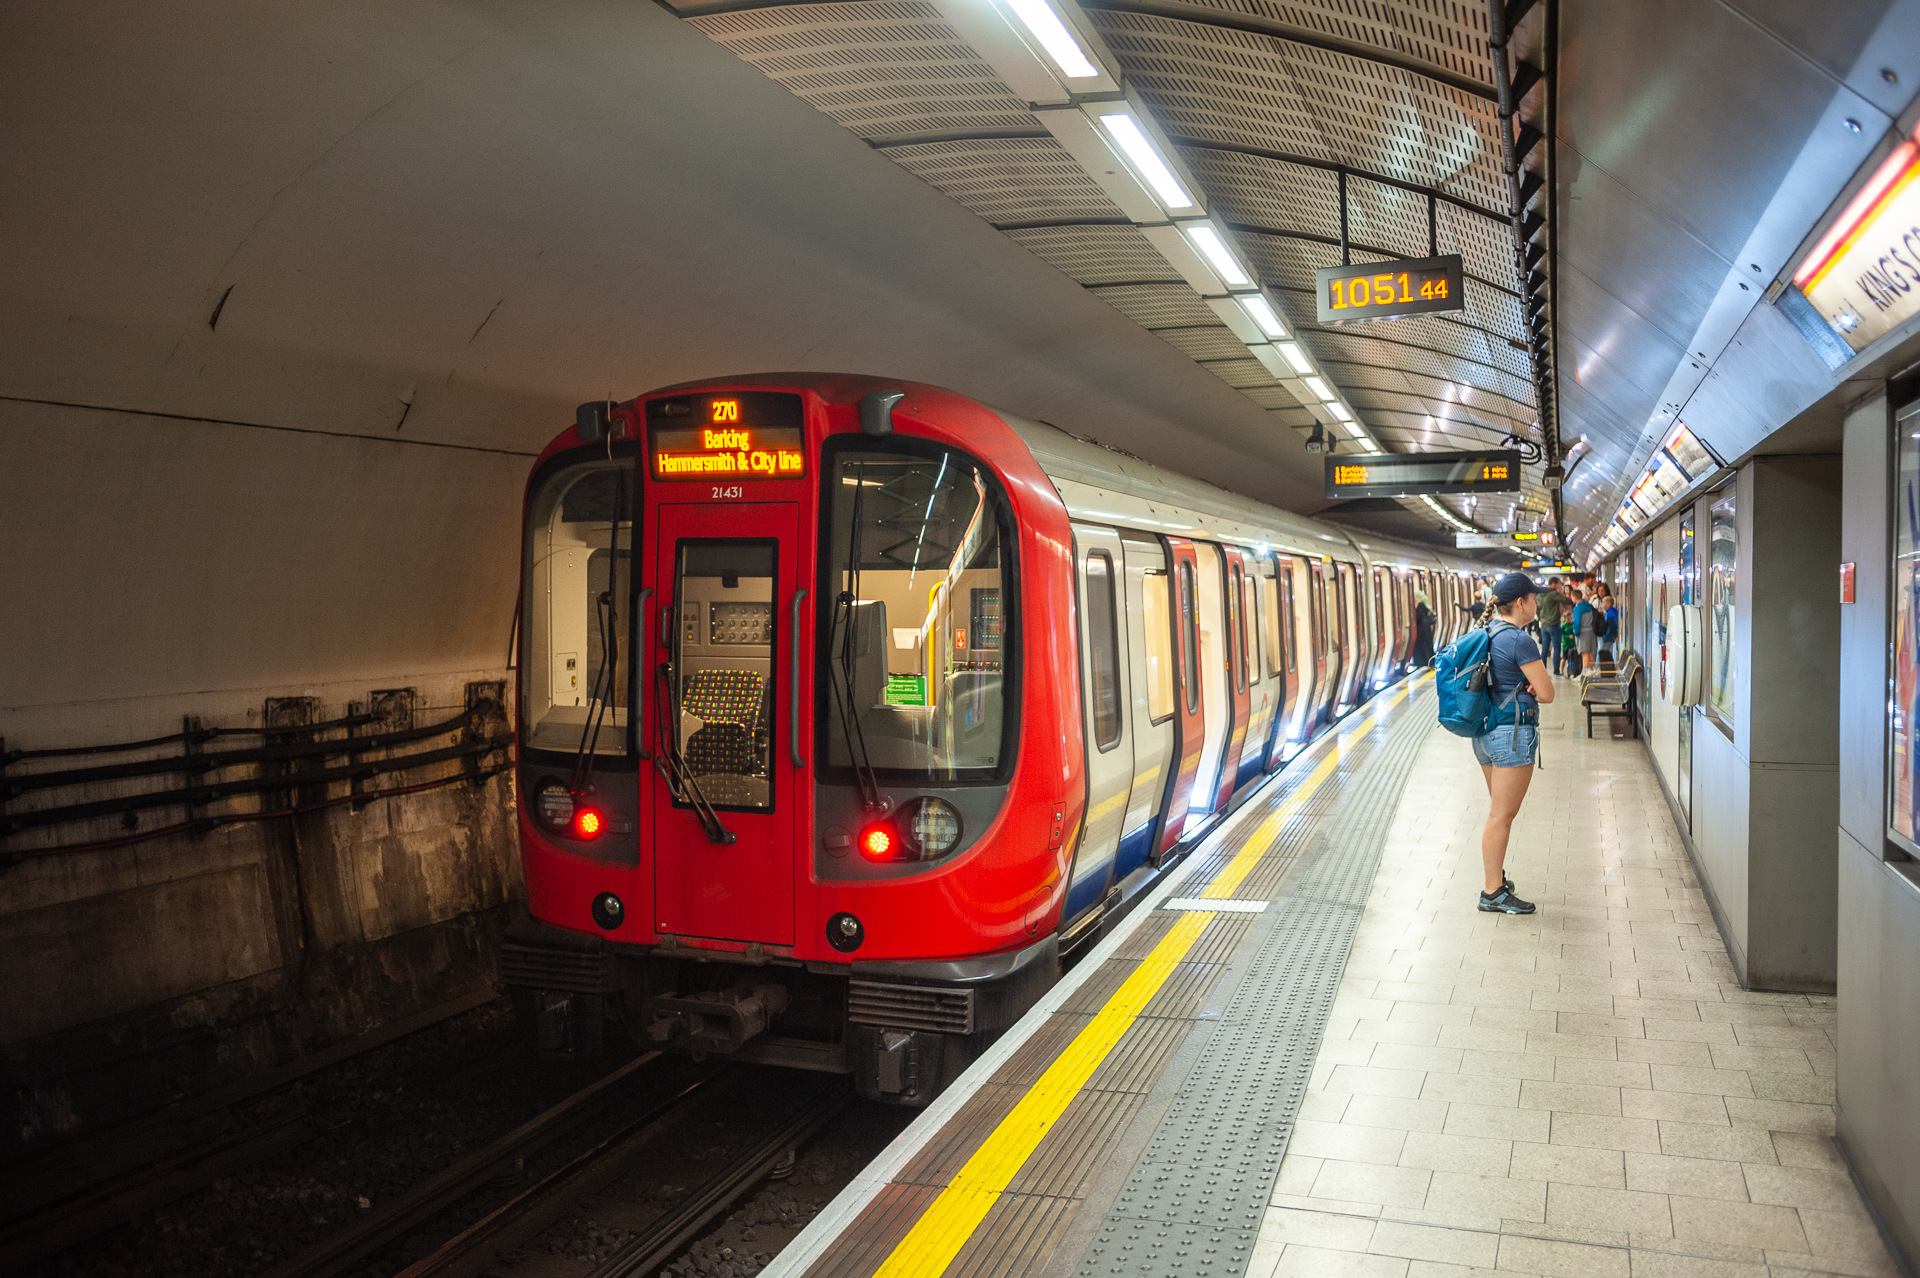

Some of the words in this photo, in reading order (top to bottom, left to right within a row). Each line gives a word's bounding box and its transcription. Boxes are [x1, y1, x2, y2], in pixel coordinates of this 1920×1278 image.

[1331, 272, 1414, 310] 1051
[1420, 279, 1449, 300] 44
[712, 400, 738, 421] 270
[704, 429, 750, 451] Barking
[658, 452, 735, 472] Hammersmith
[737, 452, 749, 470] &
[750, 451, 777, 474] City
[778, 450, 802, 470] line
[712, 486, 743, 498] 21431
